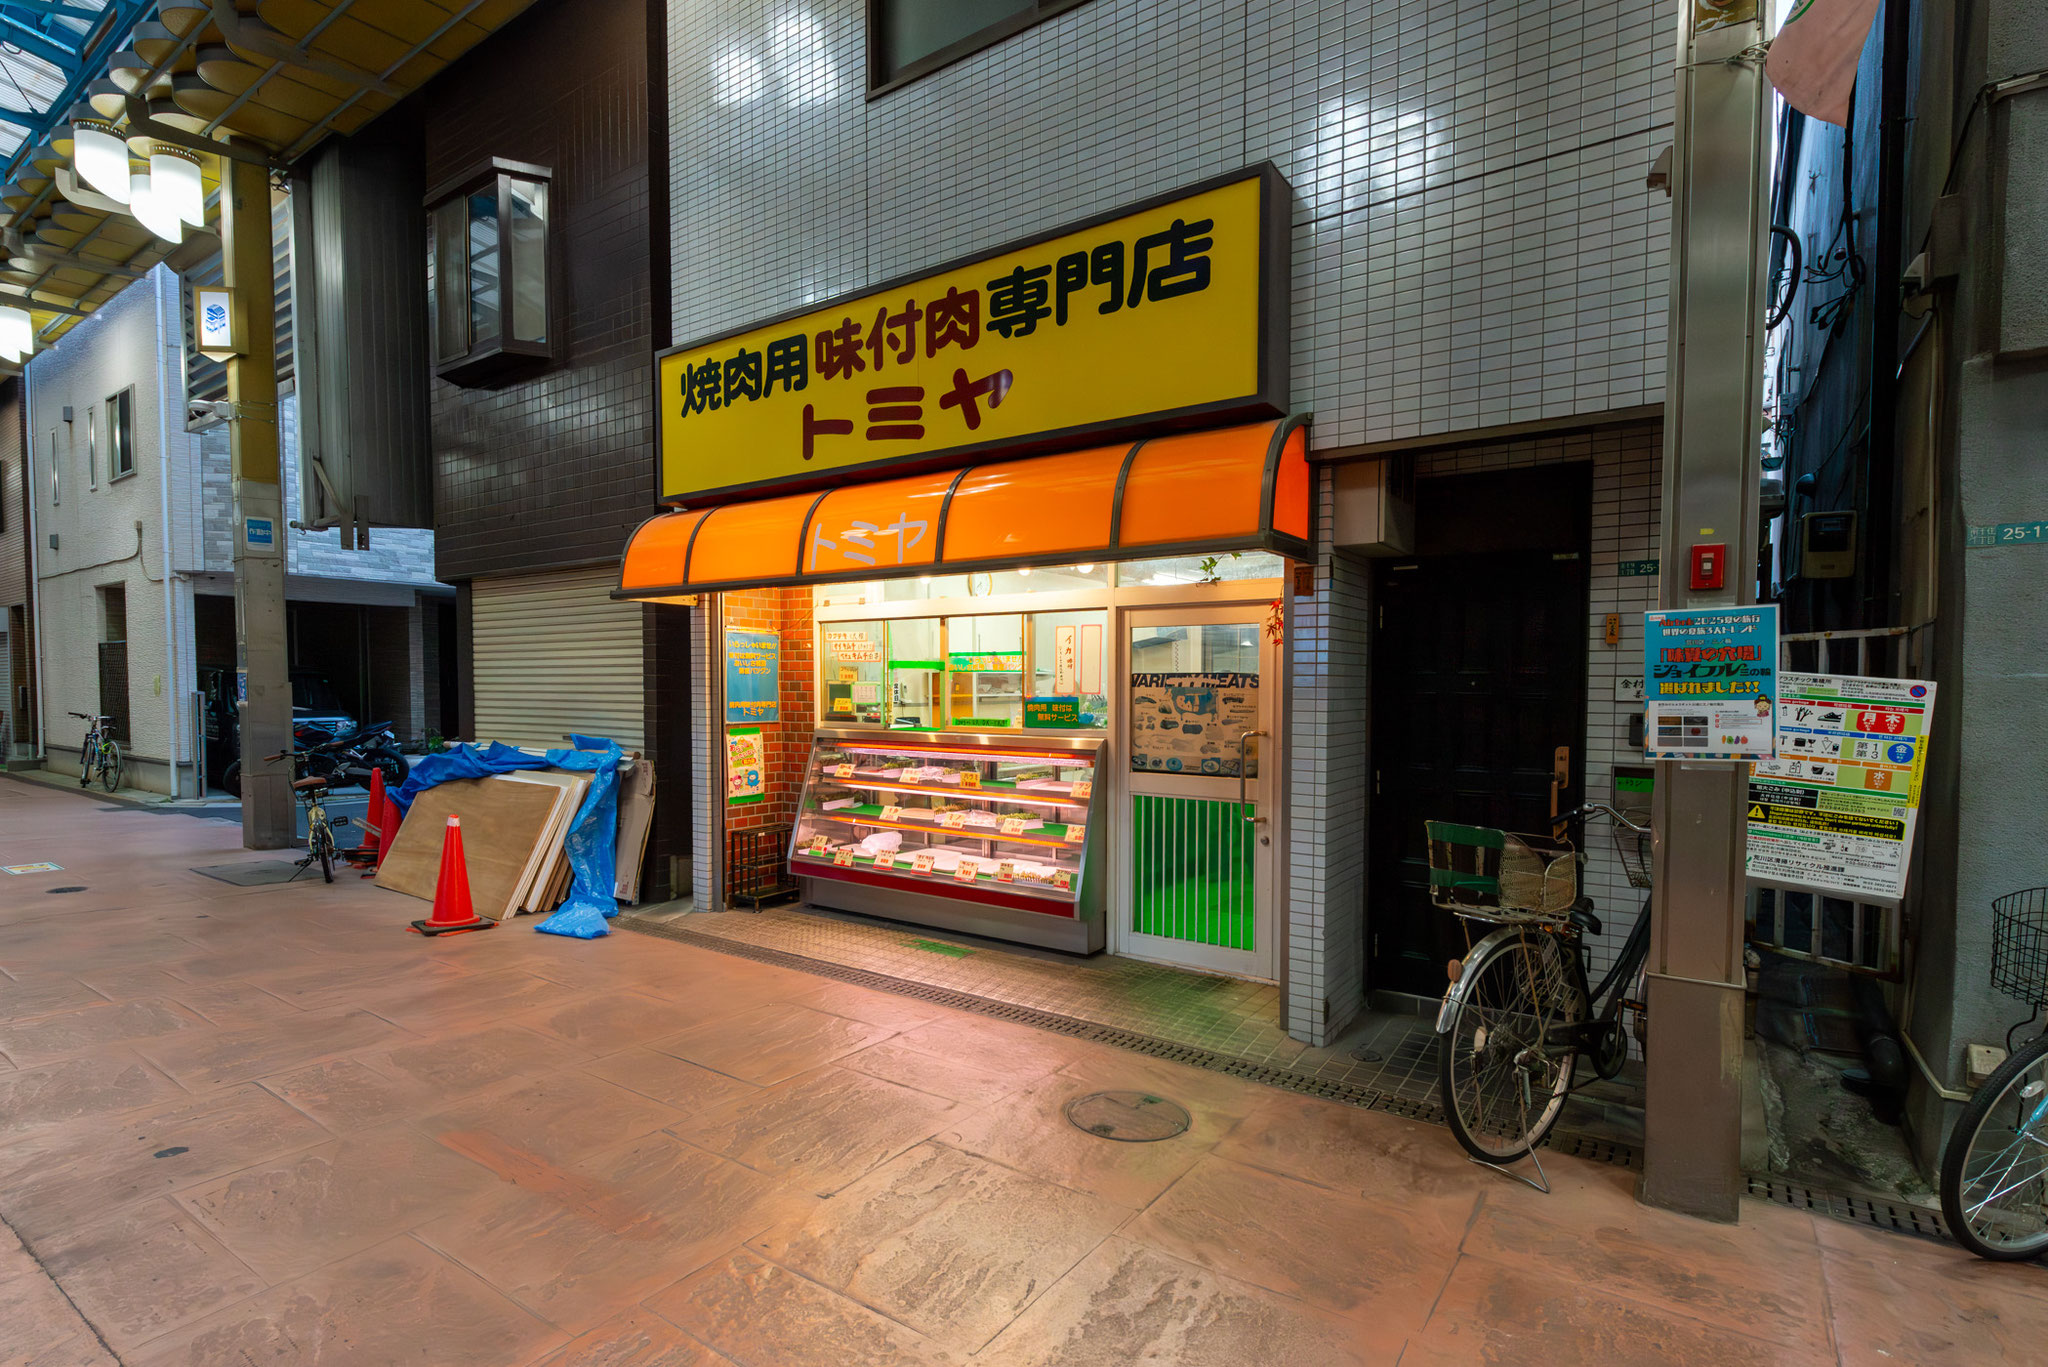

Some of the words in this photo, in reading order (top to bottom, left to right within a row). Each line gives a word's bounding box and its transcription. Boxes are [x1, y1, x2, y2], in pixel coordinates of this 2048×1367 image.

[681, 218, 1215, 419] 焼肉用味付肉専門店
[802, 368, 1014, 461] トミヤ
[810, 512, 928, 570] トミヤ
[1863, 712, 1876, 722] 月
[1885, 714, 1900, 723] 木
[1896, 744, 1907, 753] 金
[1874, 772, 1886, 780] 水
